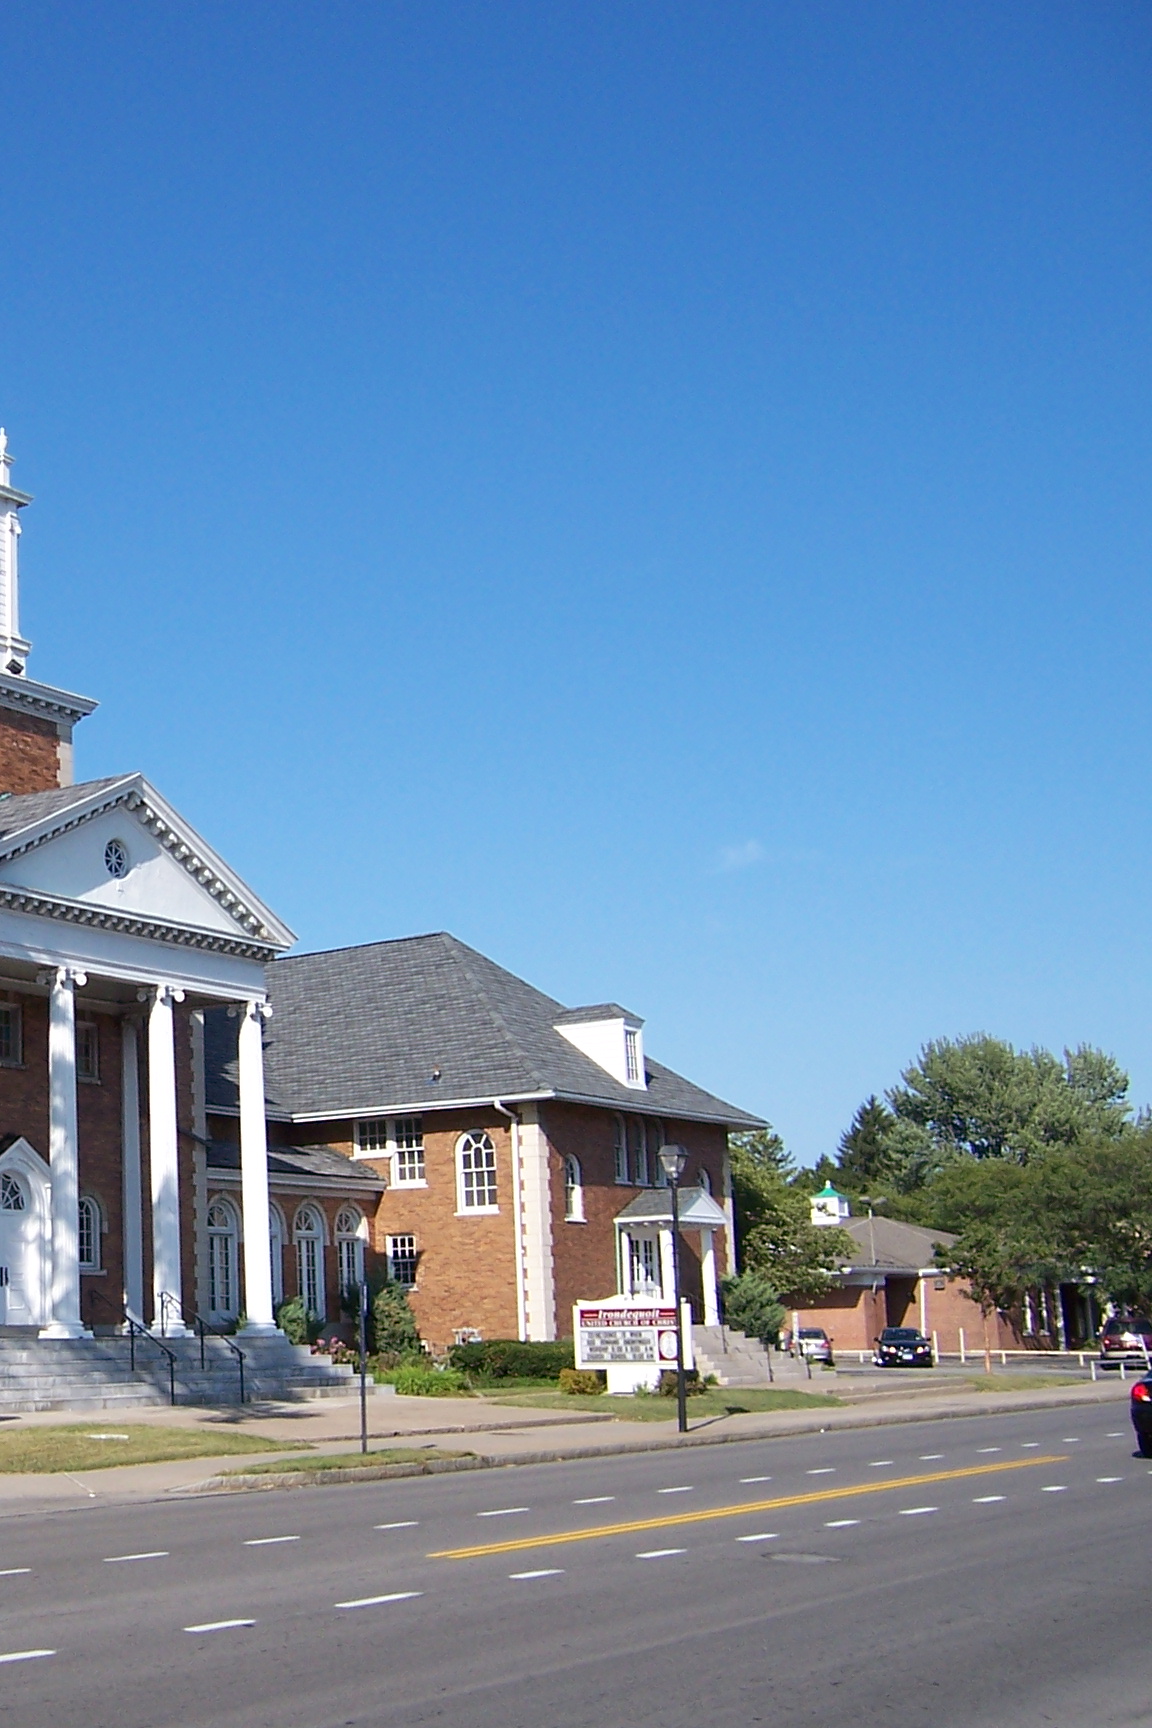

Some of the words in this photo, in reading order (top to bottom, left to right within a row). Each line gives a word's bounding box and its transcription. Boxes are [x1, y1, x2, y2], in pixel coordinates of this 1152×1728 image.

[598, 1309, 660, 1320] Irondequoit
[581, 1319, 608, 1327] UNITED
[609, 1319, 639, 1327] CHURCH
